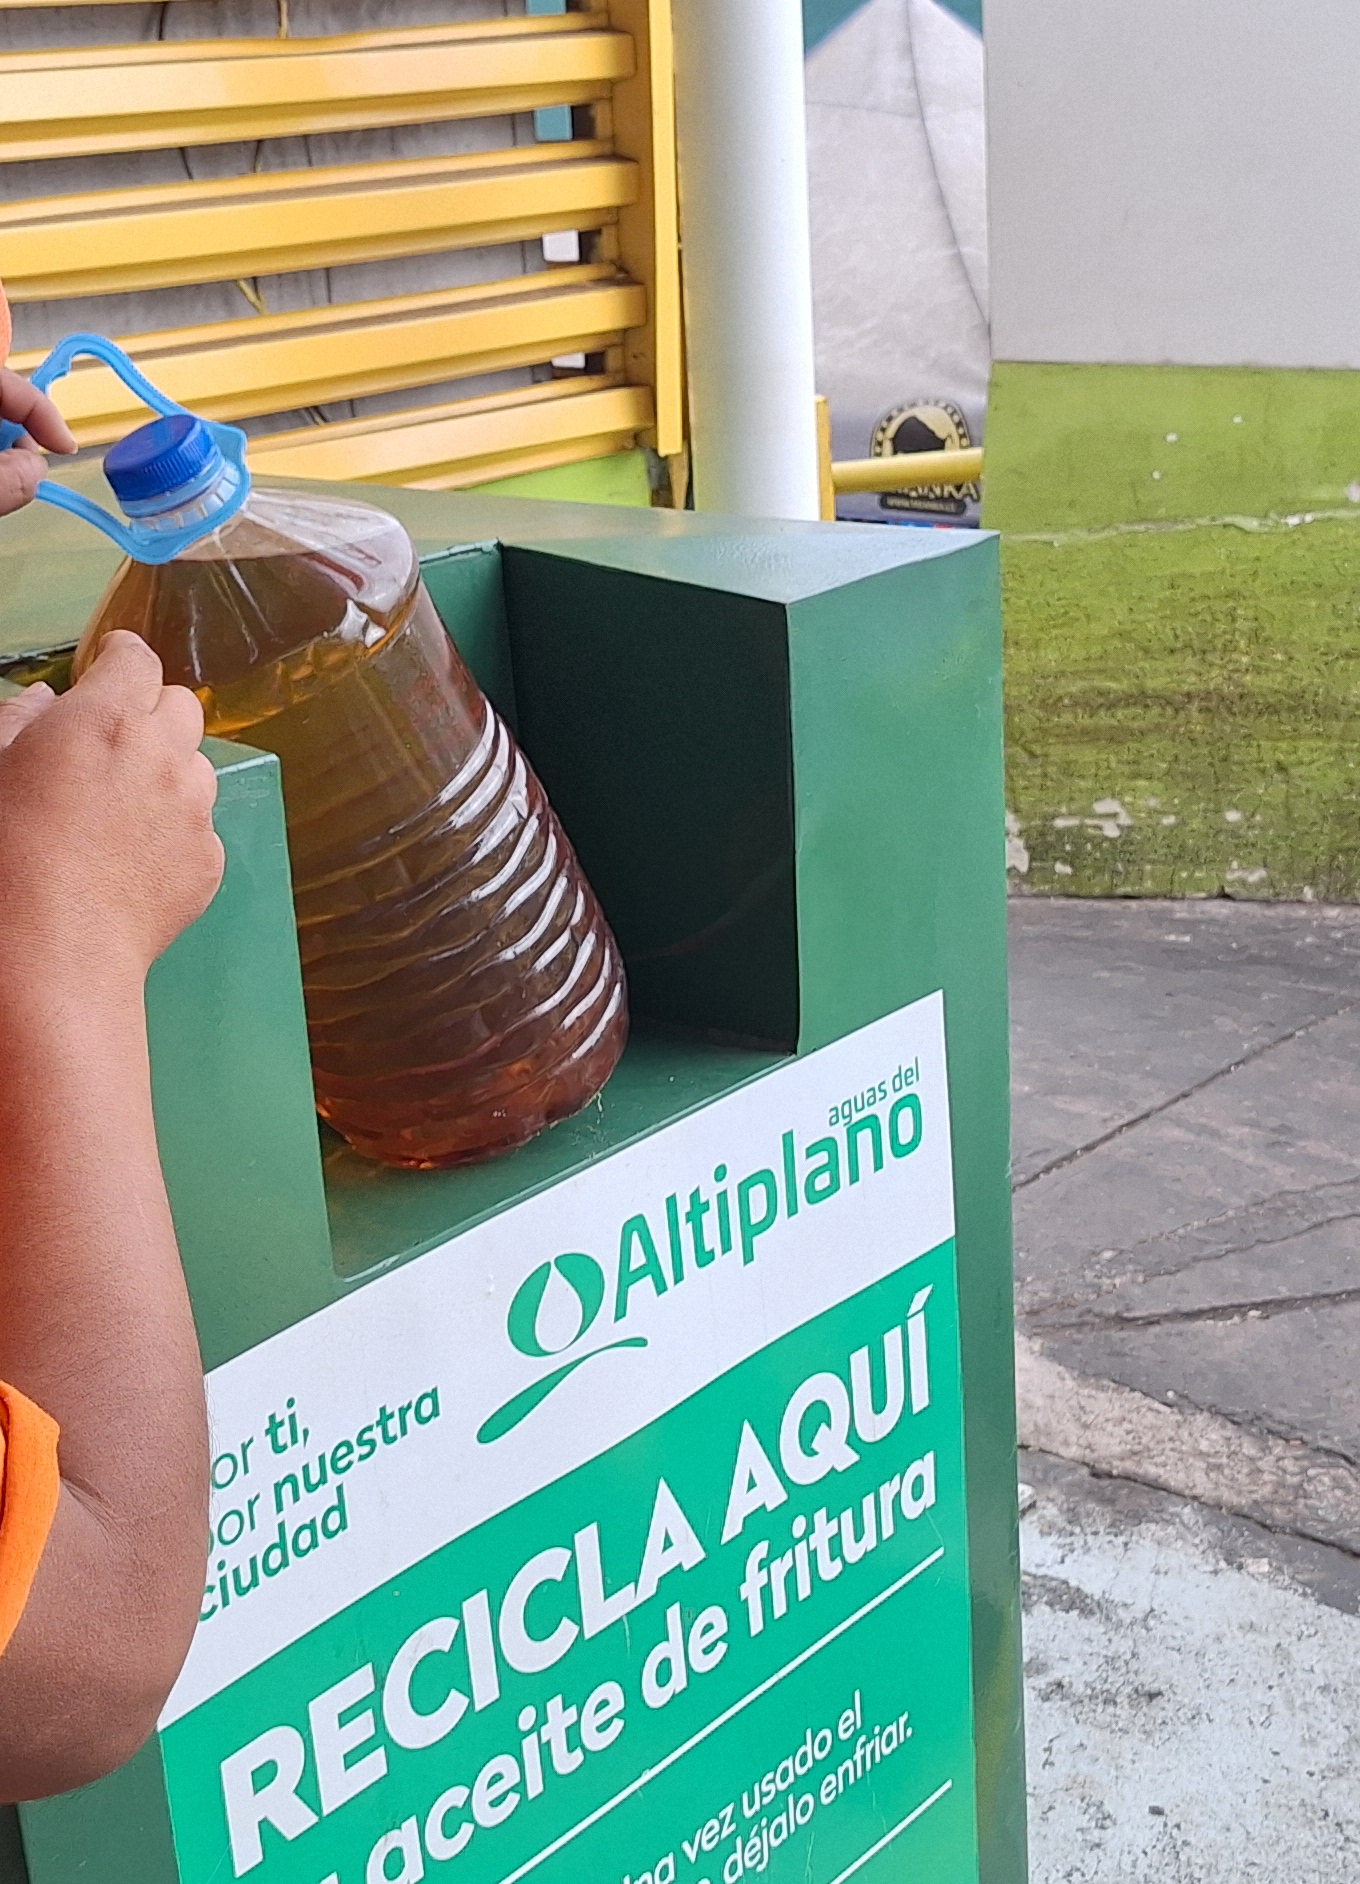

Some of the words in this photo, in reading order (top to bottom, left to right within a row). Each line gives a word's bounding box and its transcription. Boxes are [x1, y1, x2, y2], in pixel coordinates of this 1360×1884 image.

[828, 1080, 888, 1128] aguas
[891, 1056, 920, 1093] del
[613, 1092, 923, 1324] Altiplano
[207, 1492, 261, 1556] or
[272, 1386, 441, 1516] nuestra
[211, 1436, 254, 1490] or
[264, 1397, 310, 1455] ti,
[198, 1482, 349, 1622] ciudad
[220, 1477, 707, 1878] RECICLA
[720, 1283, 934, 1546] AQUÍ
[366, 1680, 626, 1884] aceite
[641, 1600, 729, 1710] de
[739, 1450, 936, 1638] fritura
[681, 1802, 737, 1864] vez
[742, 1727, 833, 1818] usado
[837, 1689, 863, 1740] el
[723, 1792, 815, 1884] déjalo
[819, 1711, 913, 1806] enfriar.
